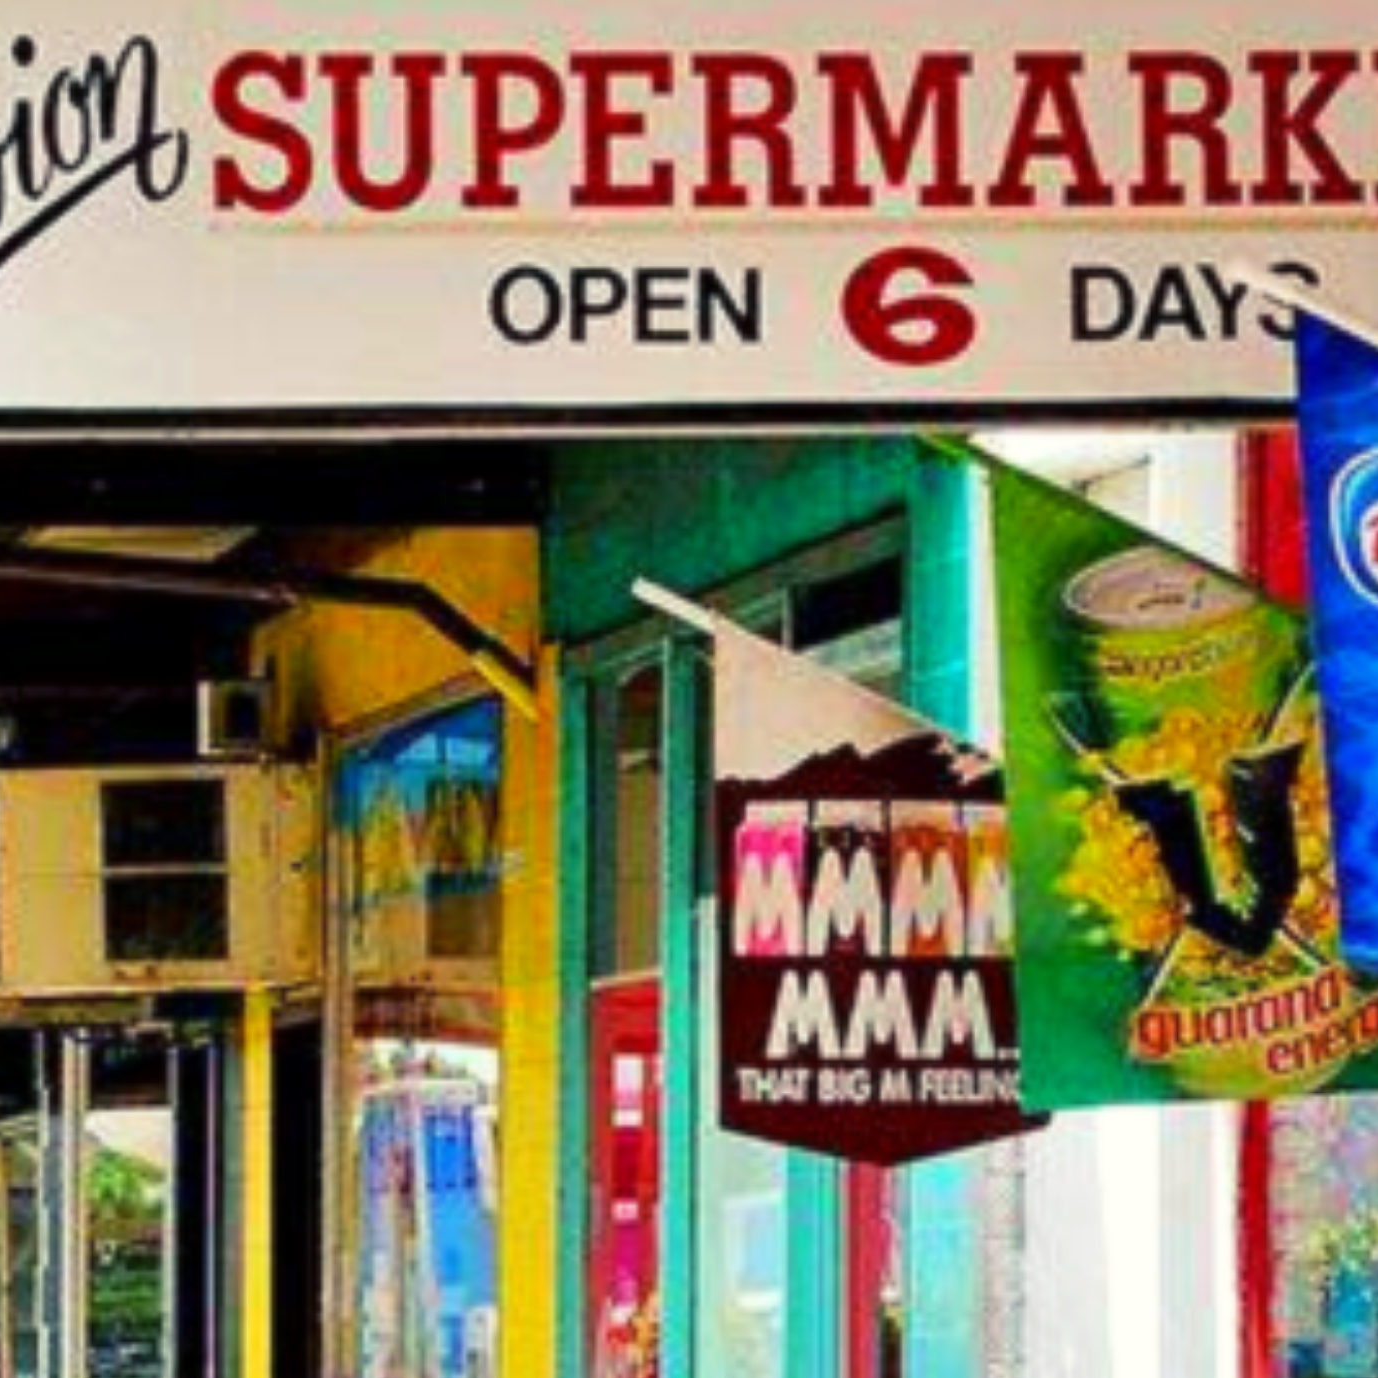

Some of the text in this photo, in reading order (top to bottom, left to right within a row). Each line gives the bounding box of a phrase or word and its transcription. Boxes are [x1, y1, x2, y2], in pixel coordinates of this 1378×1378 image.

[489, 264, 762, 343] OPEN
[841, 245, 976, 367] 6
[1136, 964, 1342, 1058] guarana
[737, 1067, 810, 1104] THAT
[817, 1067, 872, 1104] BIG
[879, 1067, 913, 1104] M
